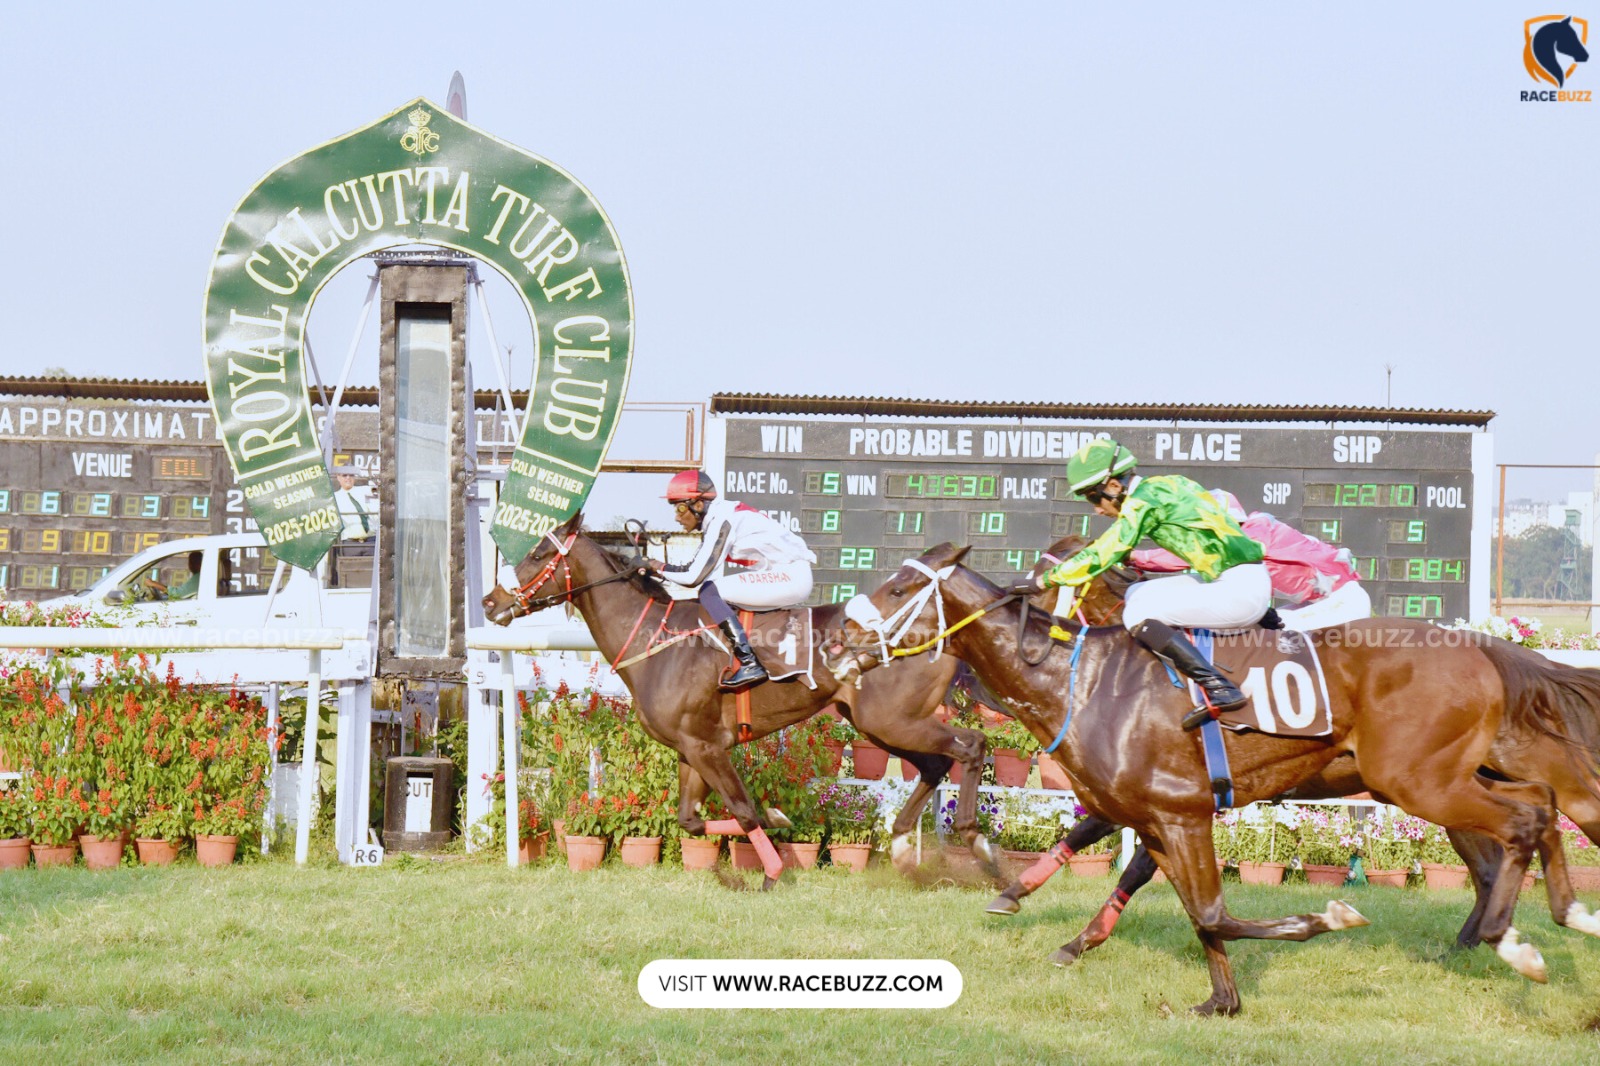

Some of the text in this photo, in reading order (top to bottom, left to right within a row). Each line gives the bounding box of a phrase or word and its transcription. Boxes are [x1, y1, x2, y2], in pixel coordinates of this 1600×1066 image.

[228, 166, 611, 462] ROYAL CALCUTTA TURF CLUB
[761, 426, 803, 453] WIN
[850, 427, 972, 457] PROBABLE
[1155, 433, 1241, 462] PLACE
[1333, 435, 1382, 464] SHP
[72, 452, 133, 478] VENUE
[161, 458, 204, 476] CAL
[511, 459, 585, 494] COLD WEATHER
[244, 465, 323, 499] COLD WEATHER
[727, 471, 794, 495] RACE No.
[821, 473, 840, 495] 5
[847, 475, 876, 496] WIN
[1003, 478, 1047, 500] PLACE
[1263, 483, 1292, 505] SHP
[41, 491, 209, 518] 6 2 3 4
[273, 487, 315, 510] SEASON
[527, 486, 570, 512] SEASON
[1427, 486, 1467, 509] POOL
[263, 505, 339, 546] 2025-2026
[495, 502, 563, 538] 2025-202
[823, 511, 839, 532] 8
[1322, 521, 1338, 541] 4
[1407, 520, 1424, 542] 5
[41, 530, 60, 551] 9
[83, 531, 109, 553] 10
[840, 548, 874, 569] 22
[739, 572, 791, 584] N DARSHAN
[778, 634, 796, 665] 1
[1241, 660, 1316, 734] 10
